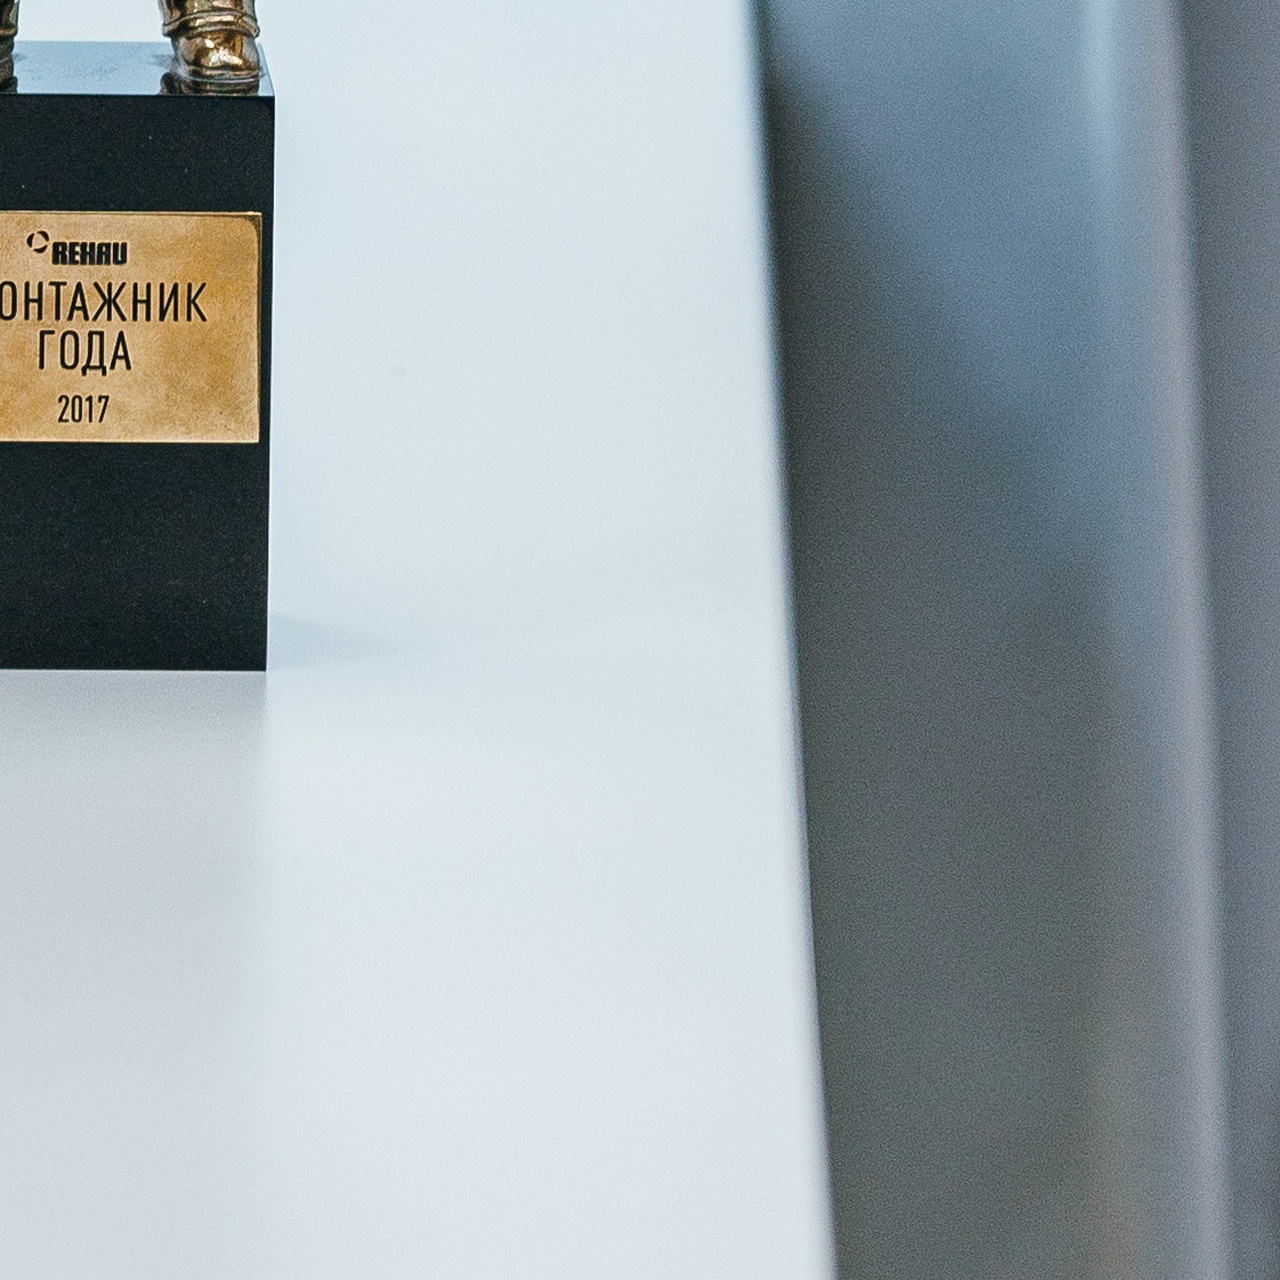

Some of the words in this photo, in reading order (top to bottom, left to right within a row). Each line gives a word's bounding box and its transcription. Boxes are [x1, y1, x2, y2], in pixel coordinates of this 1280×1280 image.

[52, 242, 128, 266] REHAU
[38, 329, 132, 376] ГОДА
[57, 394, 110, 423] 2017
